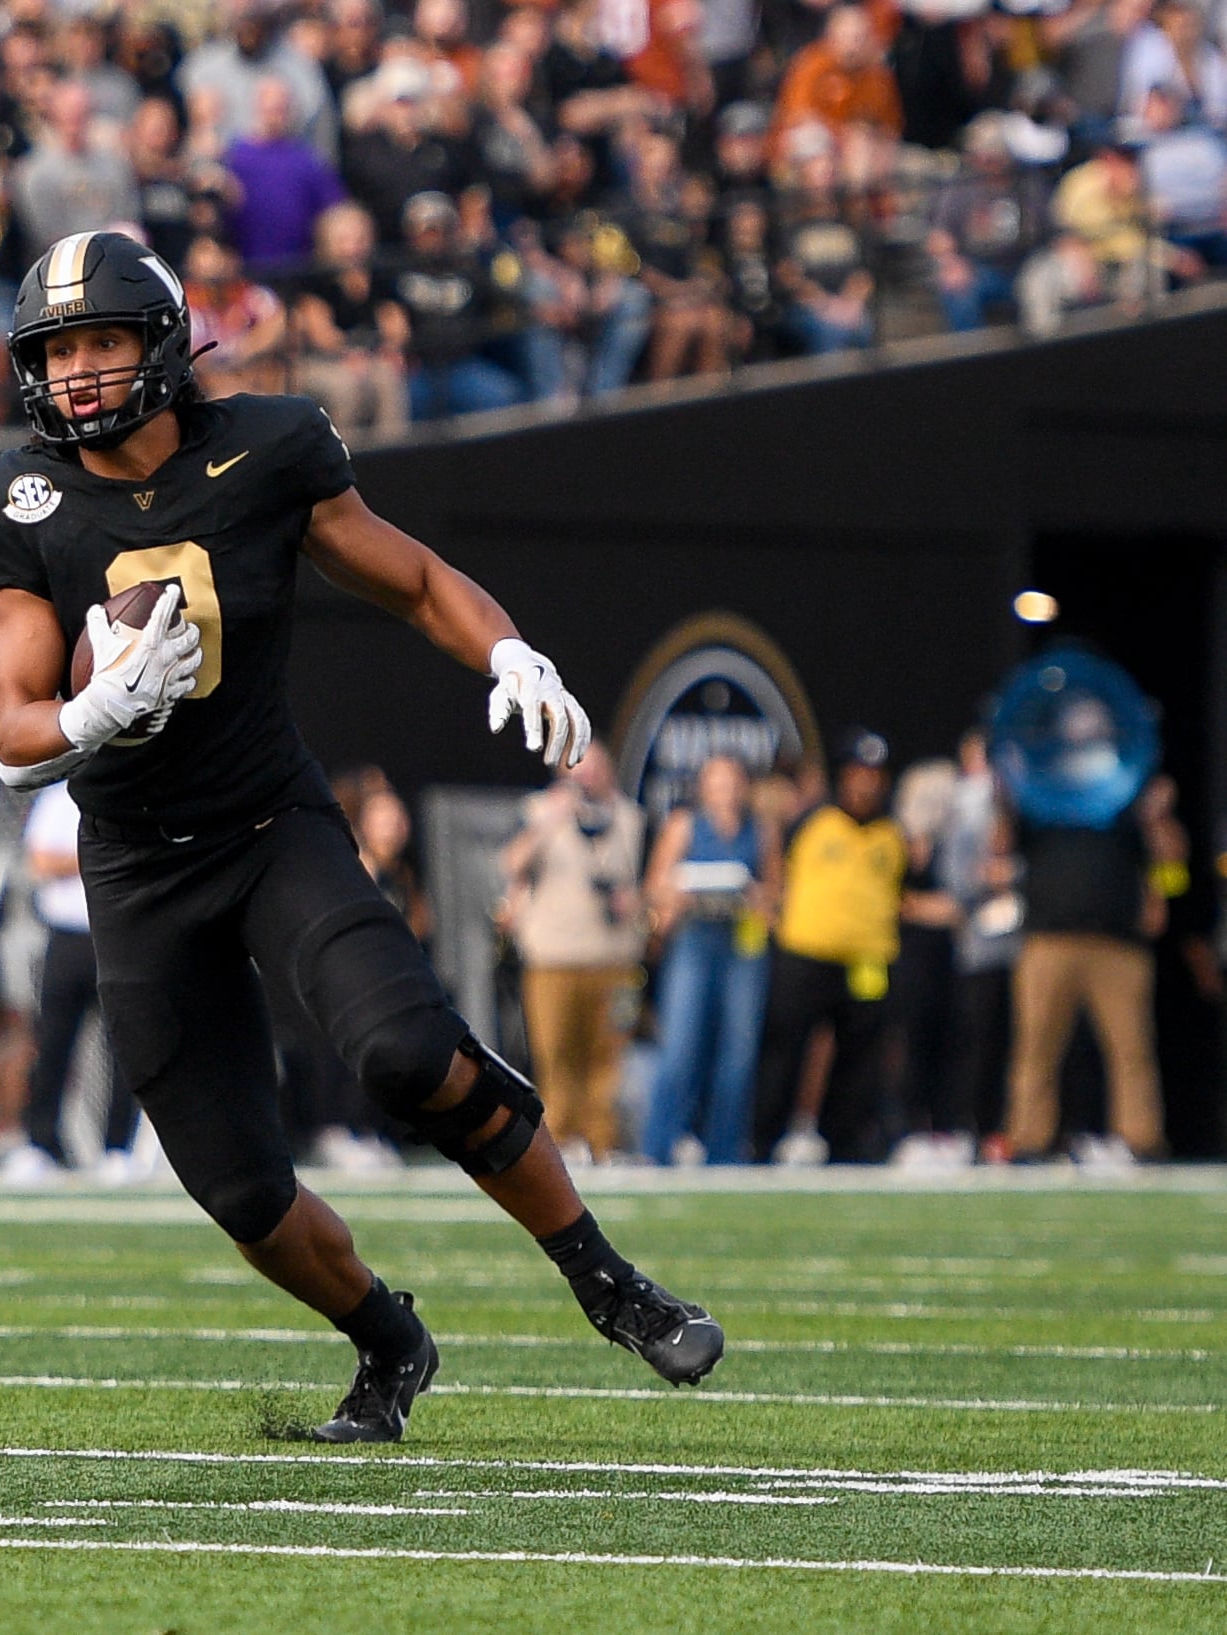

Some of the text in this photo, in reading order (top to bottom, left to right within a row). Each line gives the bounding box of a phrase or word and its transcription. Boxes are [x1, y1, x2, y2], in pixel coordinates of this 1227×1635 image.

[11, 476, 50, 509] SEC
[134, 491, 154, 511] V
[13, 500, 56, 520] GRADUATE
